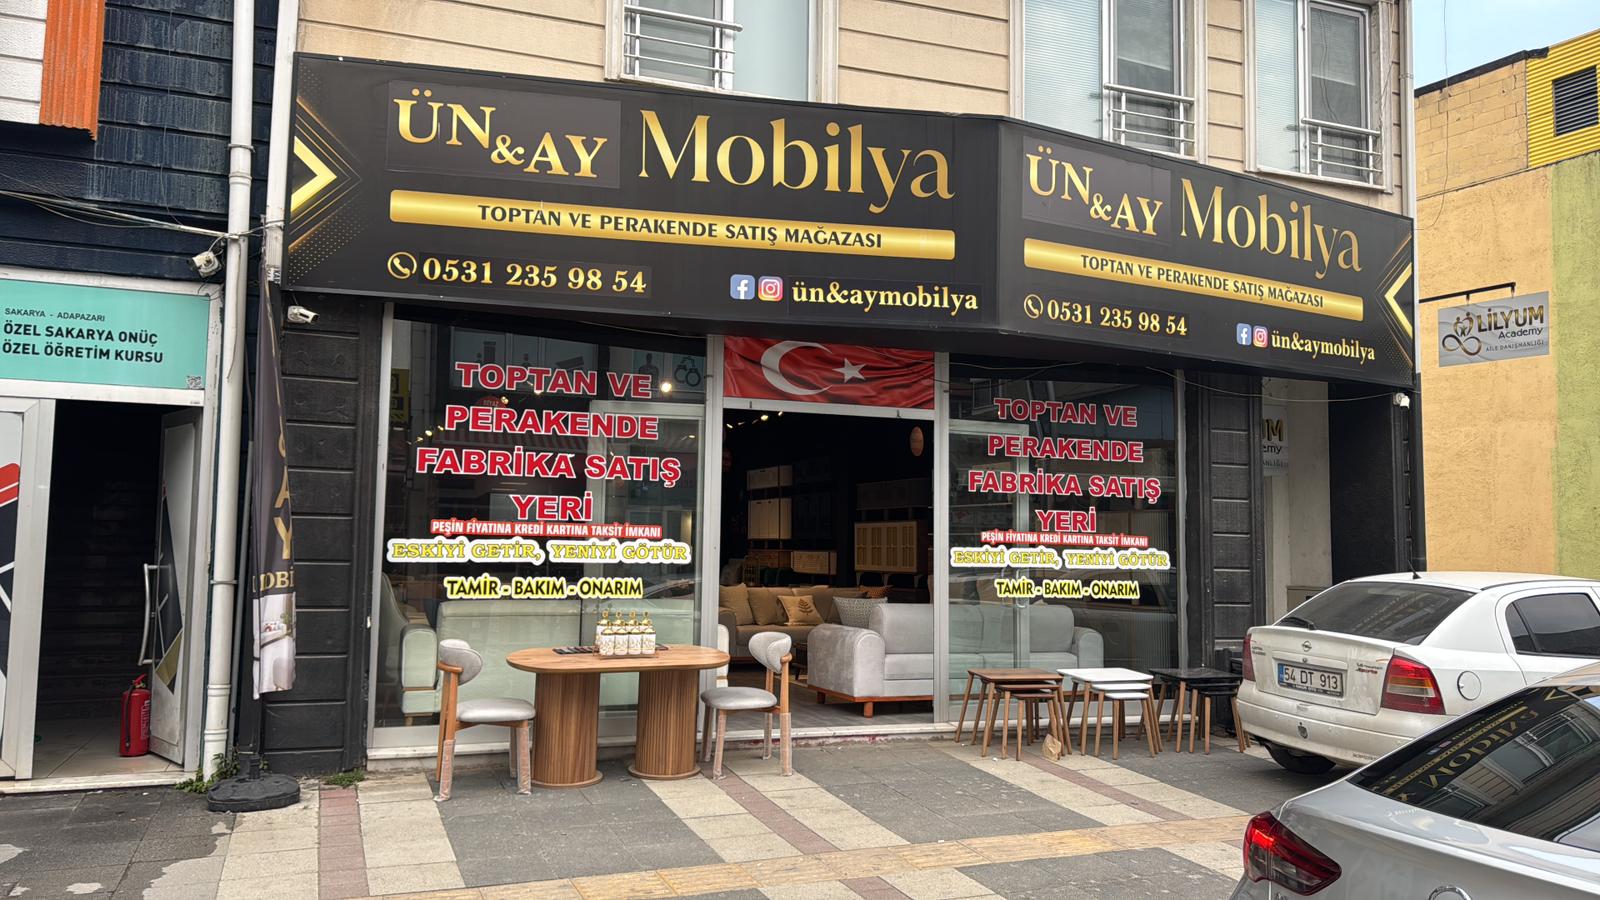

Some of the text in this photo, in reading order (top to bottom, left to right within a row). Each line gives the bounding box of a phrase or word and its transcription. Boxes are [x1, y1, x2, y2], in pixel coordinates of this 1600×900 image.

[638, 110, 956, 214] Mobilya
[478, 204, 882, 248] TOPTAN VE PERAKENDE SATIŞ MAĞAZASI
[1180, 178, 1362, 279] Mobilya
[422, 258, 646, 293] 0531 235 98 54
[1081, 254, 1324, 308] TOPTAN VE PERAKENDE SATIŞ MAĞAZASI
[792, 282, 978, 316] ün&aymobilya
[4, 307, 46, 318] SAKARYA
[57, 312, 106, 322] ADAPAZARI
[1048, 302, 1188, 336] 0531 235 98 54
[1476, 305, 1544, 332] LİLYUM
[3, 320, 158, 347] ÖZEL SAKARYA ONÜÇ
[1272, 328, 1375, 365] ün&aymobilya
[1498, 327, 1543, 339] Academy
[2, 339, 163, 364] ÖZEL ÖĞRETİM KURSU
[456, 362, 651, 398] TOPTAN VE
[445, 404, 658, 440] PERAKENDE
[994, 398, 1138, 427] TOPTAN VE
[988, 435, 1144, 463] PERAKENDE
[416, 446, 681, 487] FABRİKA SATIŞ
[968, 468, 1162, 504] FABRİKA SATIŞ
[510, 492, 592, 521] YERİ
[1036, 507, 1096, 532] YERİ
[432, 520, 660, 538] PEŞİN FİYATINA KREDİ KARTINA TAKSİT İMKANI
[981, 530, 1148, 546] PEŞİN FİYATINA KREDİ KARTINA TAKSİT İMKANI
[392, 541, 687, 562] ESKİYİ GETİR, YENİYİ GÖTÜR
[954, 549, 1167, 567] ESKİYİ GETİR, YENİYİ GÖTÜR
[447, 576, 498, 596] TAMİR
[514, 580, 564, 596] BAKIM
[580, 580, 642, 596] ONARIM
[997, 579, 1034, 594] TAMİR
[1044, 582, 1080, 596] BAKIM
[1092, 583, 1138, 596] ONARIM
[1284, 668, 1338, 690] 54 DT 913
